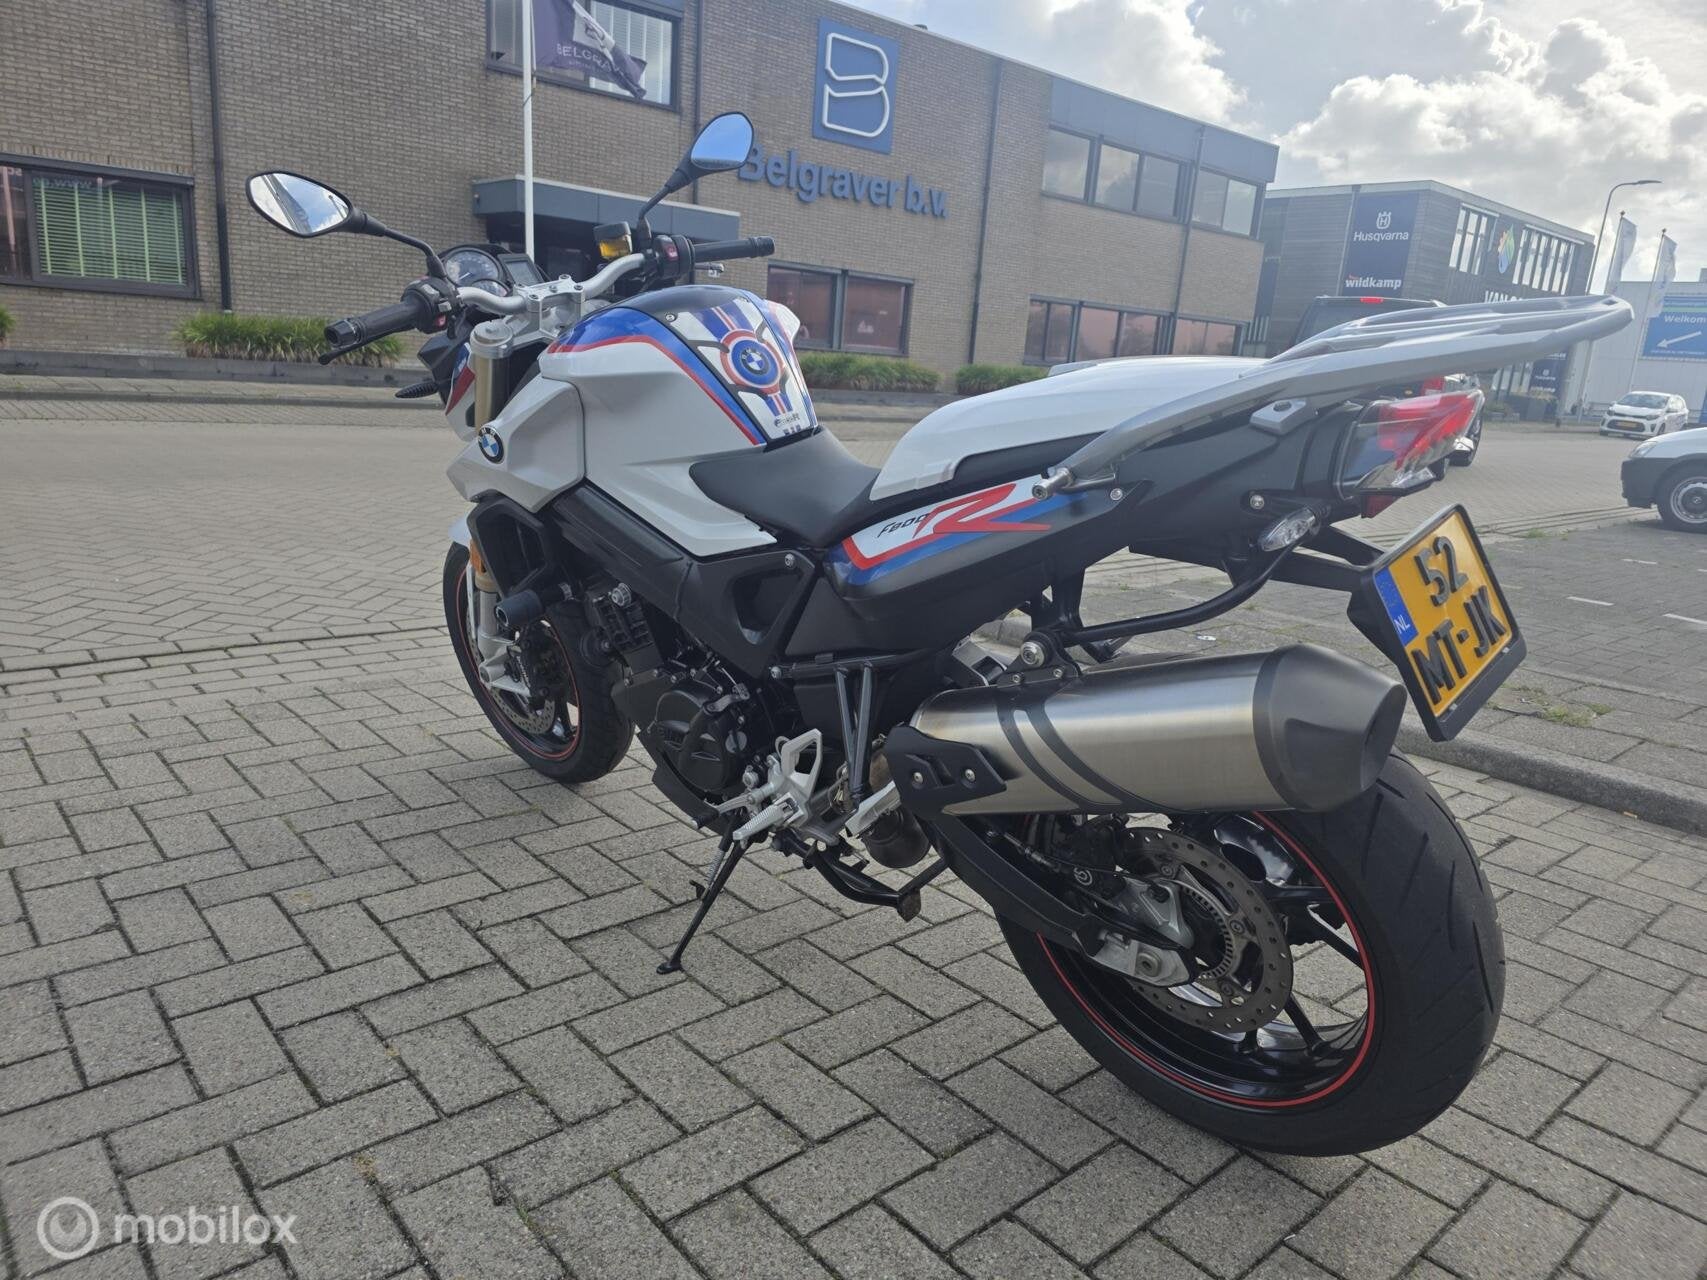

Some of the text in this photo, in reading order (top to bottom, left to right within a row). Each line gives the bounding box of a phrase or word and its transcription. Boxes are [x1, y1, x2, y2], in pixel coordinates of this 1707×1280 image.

[738, 144, 951, 219] Belgraver b.v.
[1353, 231, 1409, 242] Husqvarna
[1345, 276, 1402, 290] wildkamp
[1664, 313, 1707, 324] Welkom
[1414, 536, 1469, 607] 52
[1394, 614, 1411, 634] NL
[1411, 585, 1506, 706] MT-JK
